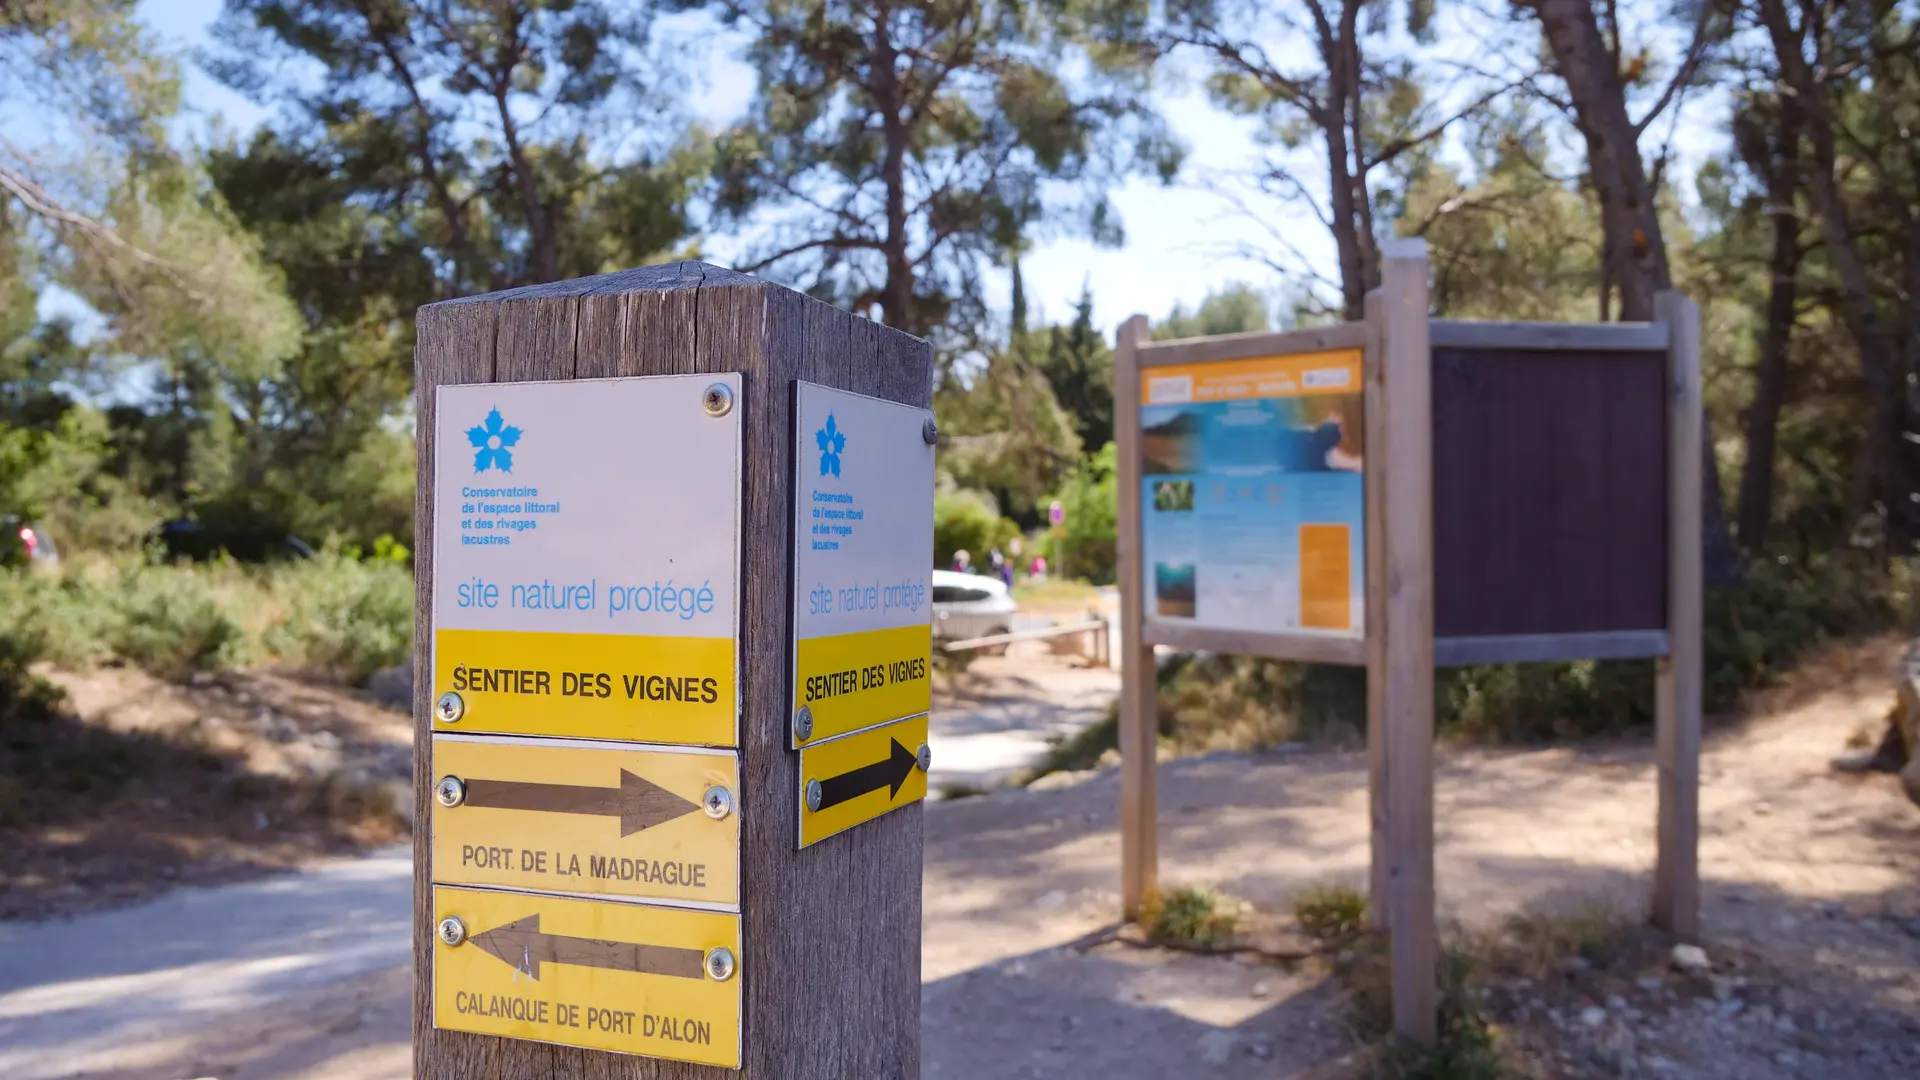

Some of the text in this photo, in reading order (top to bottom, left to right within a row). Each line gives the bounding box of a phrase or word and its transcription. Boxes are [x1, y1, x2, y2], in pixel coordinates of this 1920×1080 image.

[462, 486, 538, 497] Conservatoire
[462, 502, 560, 515] de l'espace littoral
[813, 506, 820, 518] de
[461, 518, 536, 532] et des rivages
[812, 524, 819, 534] et
[820, 524, 830, 534] des
[461, 534, 510, 545] lacustres
[458, 577, 715, 620] site naturel protégé
[809, 578, 924, 615] site naturel protégé
[453, 667, 718, 703] SENTIER DES VIGNES
[806, 657, 925, 702] SENTIER DES VIGNES
[521, 849, 547, 874] DE
[556, 852, 582, 877] LA
[590, 855, 706, 888] MADRAGUE
[455, 991, 711, 1045] CALANQUE DE PORT D'ALON
